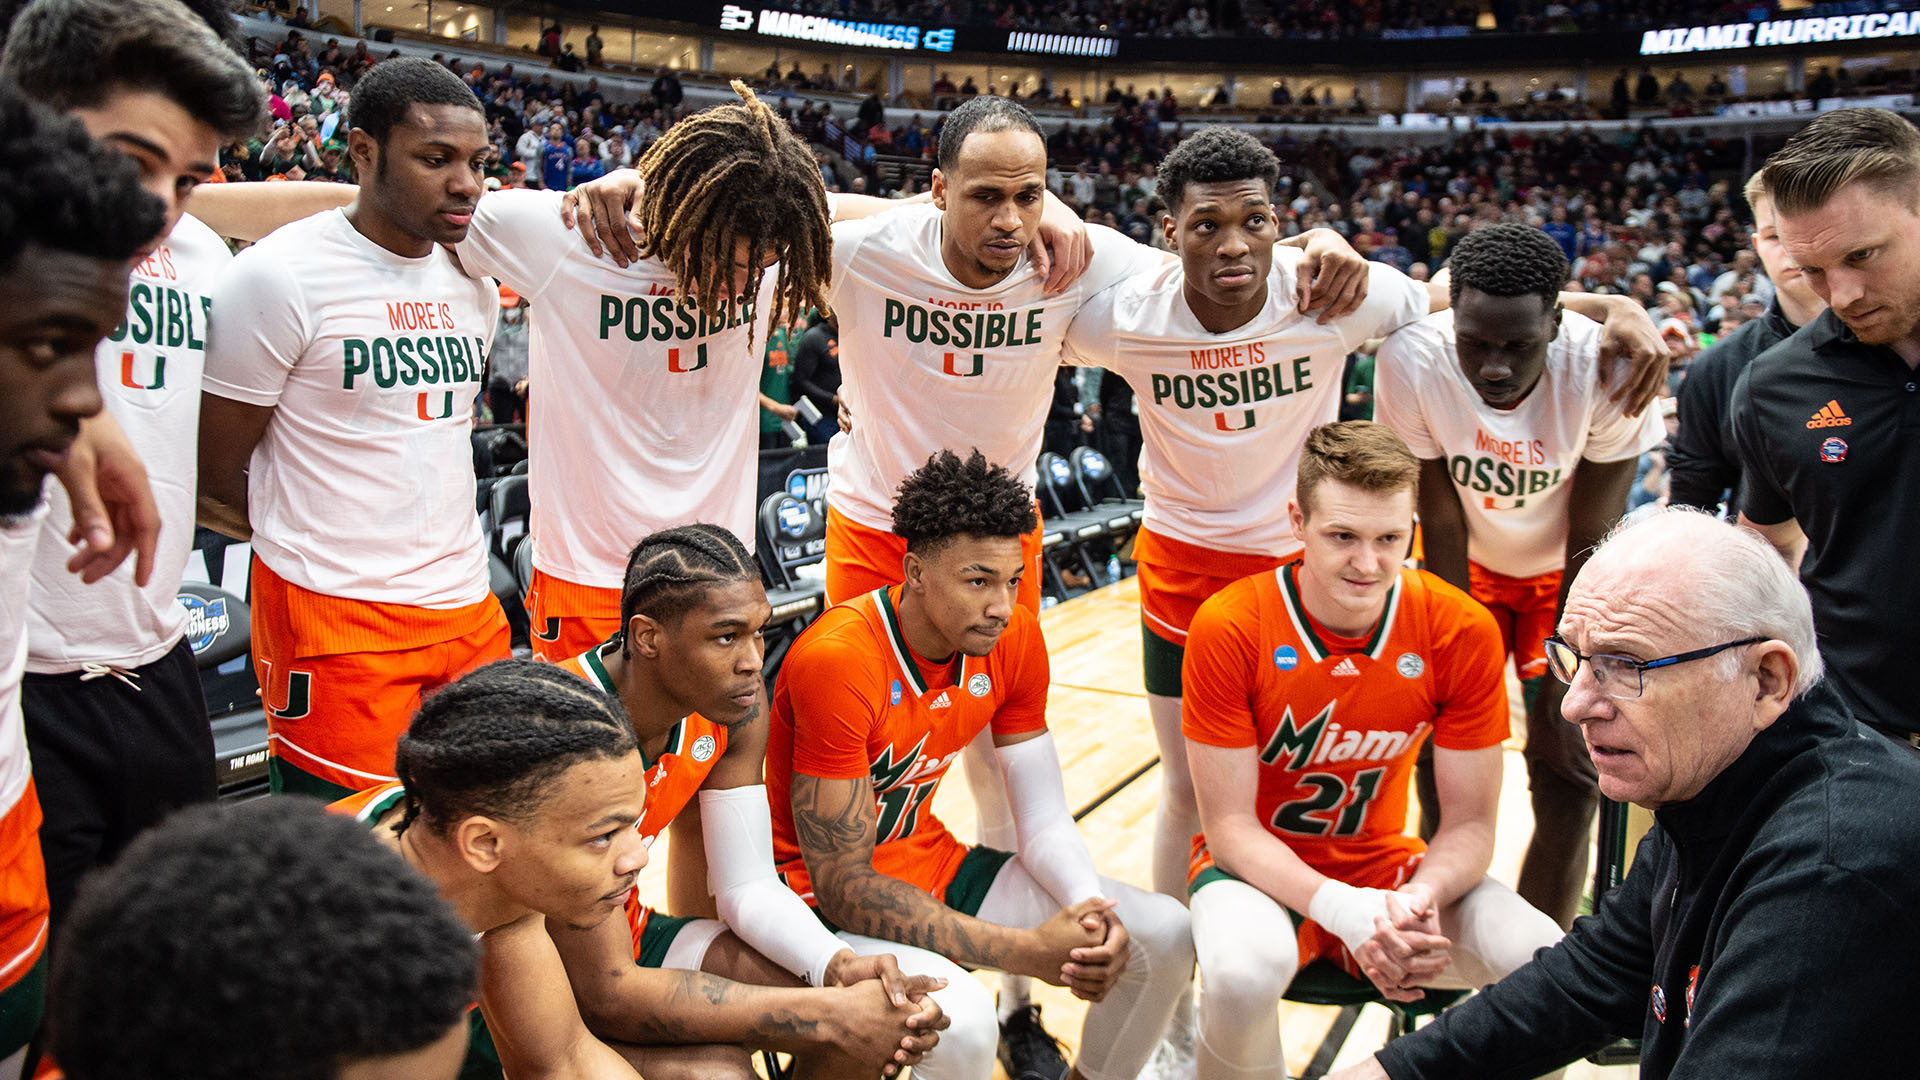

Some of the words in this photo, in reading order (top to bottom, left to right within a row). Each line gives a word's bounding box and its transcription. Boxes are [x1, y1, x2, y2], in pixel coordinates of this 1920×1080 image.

[1639, 23, 1755, 55] MIAMI
[386, 302, 438, 331] MORE
[437, 303, 455, 329] IS
[884, 298, 1044, 349] POSSIBLE
[120, 352, 167, 390] U
[668, 342, 708, 373] U
[943, 353, 984, 377] U
[1190, 345, 1244, 370] MORE
[1248, 341, 1265, 365] IS
[1152, 356, 1313, 409] POSSIBLE
[417, 391, 453, 421] U
[1214, 409, 1256, 432] U
[1806, 417, 1852, 430] adidas
[1475, 429, 1524, 465] MORE
[1527, 439, 1545, 465] IS
[261, 658, 312, 719] U
[230, 755, 245, 771] THE
[245, 750, 266, 767] ROAD
[876, 777, 940, 845] 11
[1270, 766, 1388, 837] 21
